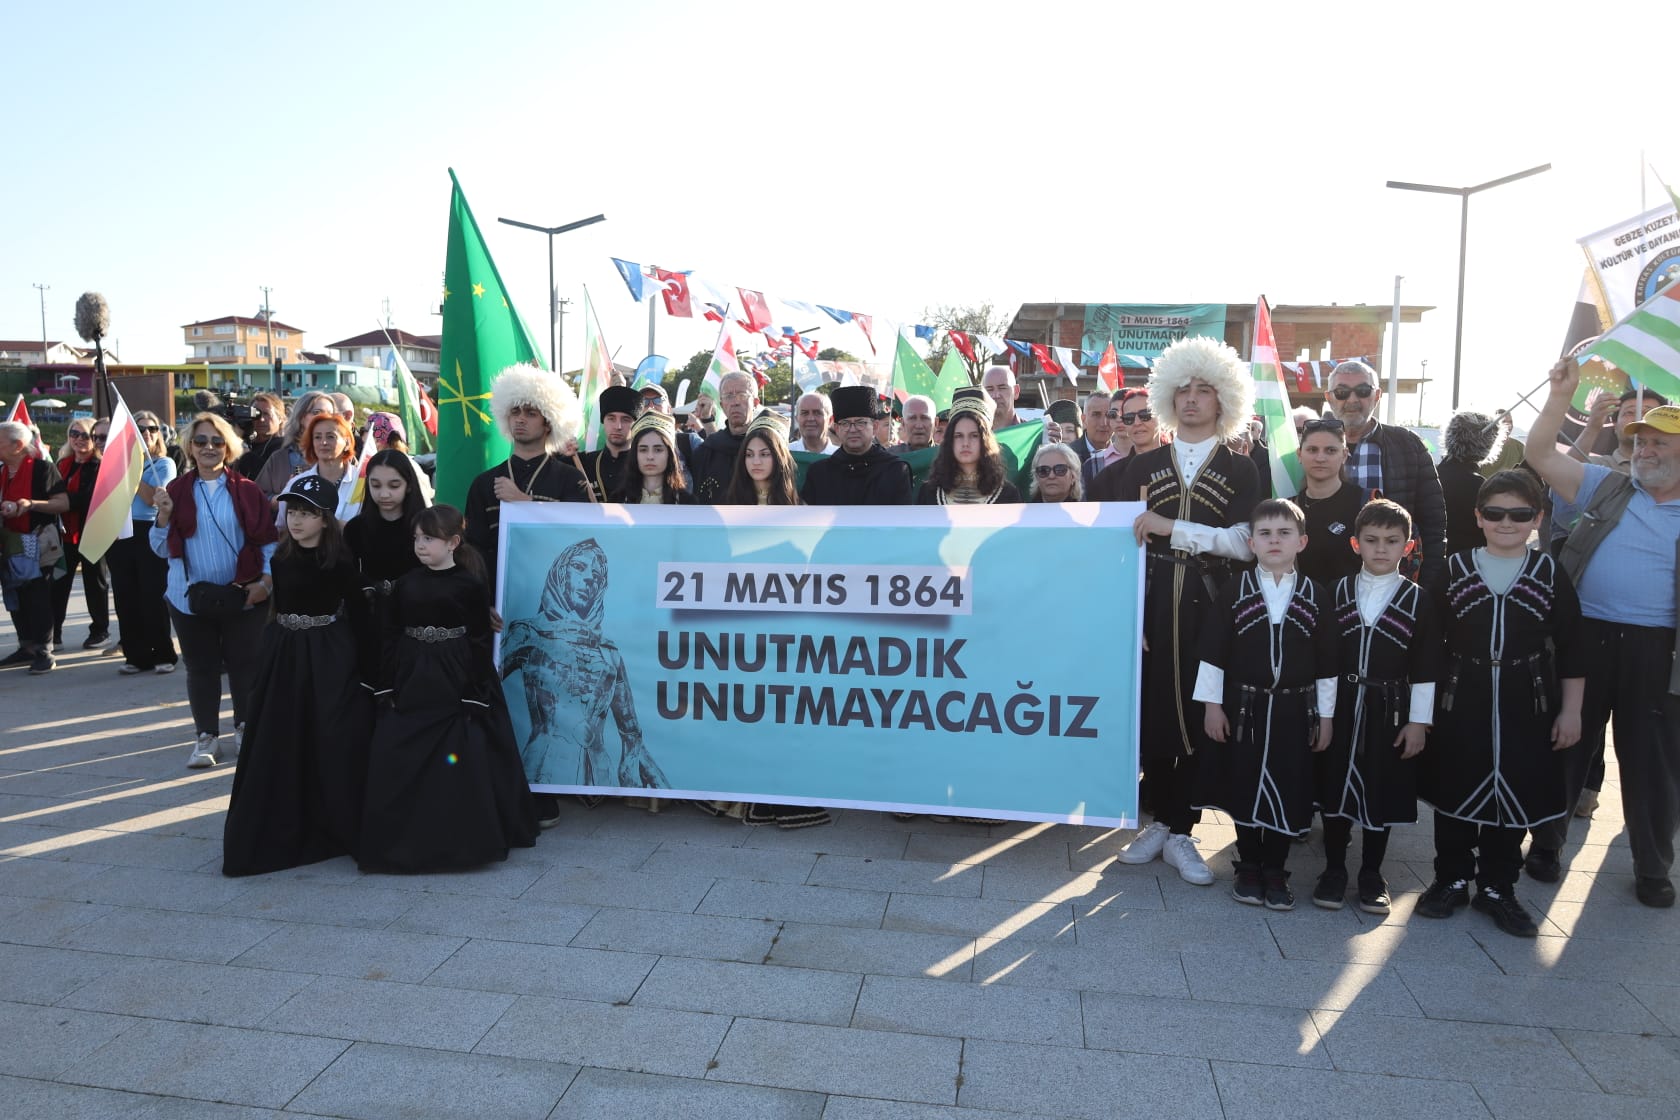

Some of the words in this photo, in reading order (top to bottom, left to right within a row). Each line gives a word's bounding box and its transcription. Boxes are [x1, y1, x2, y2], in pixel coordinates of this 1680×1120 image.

[1614, 228, 1644, 247] GEBZE
[1644, 214, 1673, 234] KUZEY
[1634, 243, 1648, 255] VE
[1648, 229, 1680, 249] DAYANI
[1118, 329, 1189, 340] UNUTMADIK
[1120, 315, 1130, 324] 21
[1134, 316, 1163, 325] MAYIS
[1167, 317, 1189, 325] 1864
[663, 571, 704, 602] 21
[724, 572, 847, 606] MAYIS
[865, 574, 964, 608] 1864
[657, 630, 968, 679] UNUTMADIK
[656, 680, 1100, 739] UNUTMAYACAĞIZ
